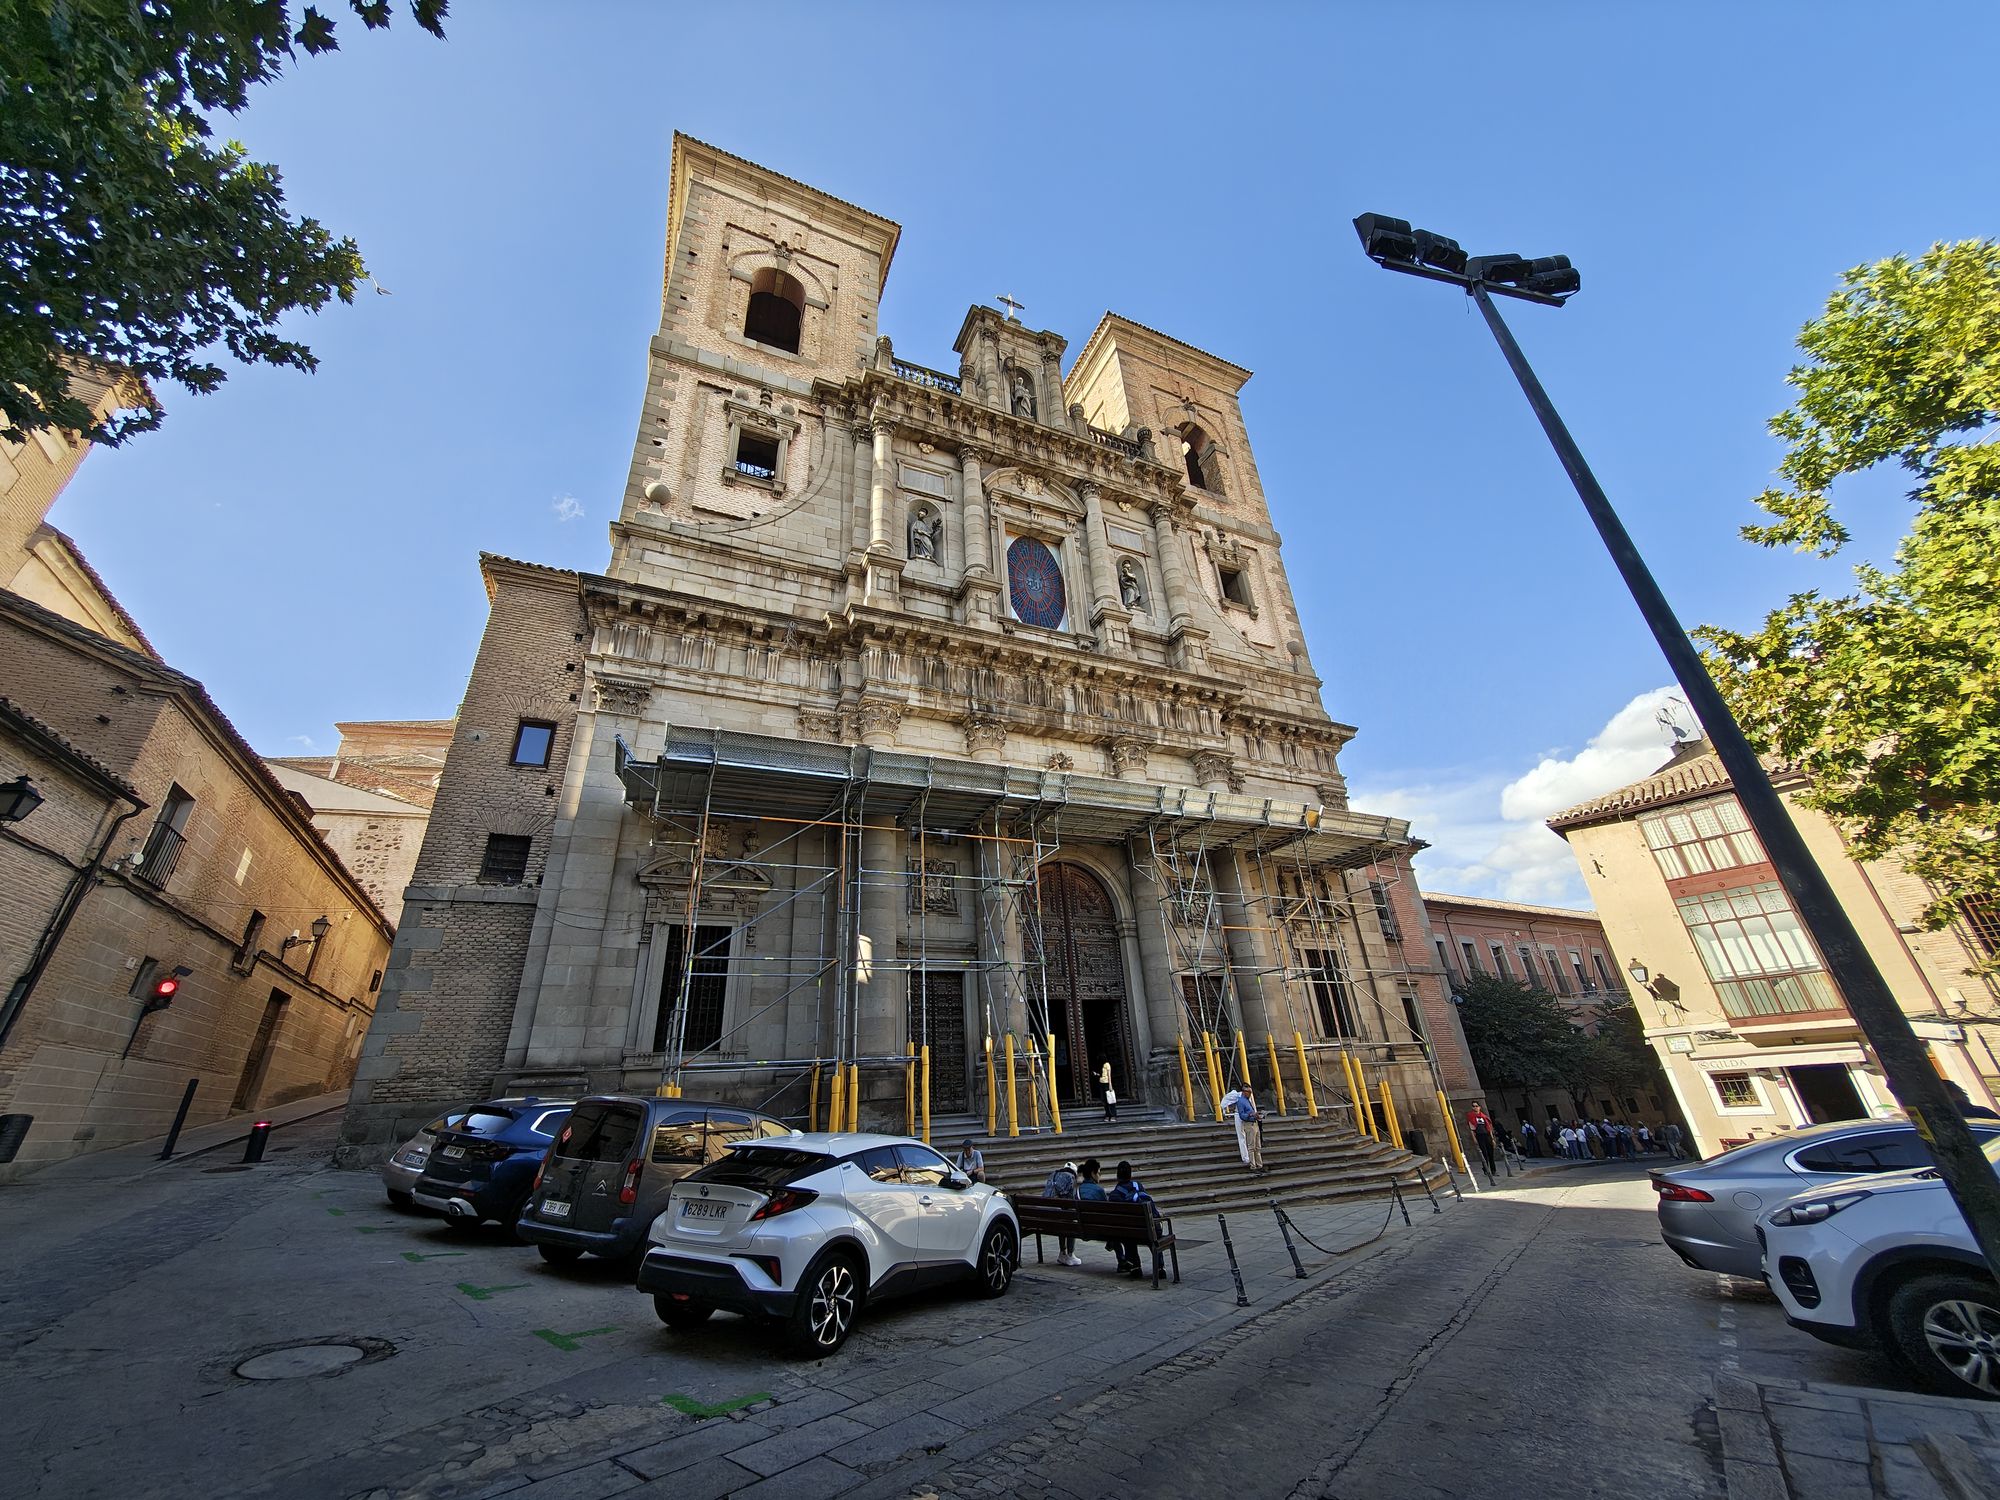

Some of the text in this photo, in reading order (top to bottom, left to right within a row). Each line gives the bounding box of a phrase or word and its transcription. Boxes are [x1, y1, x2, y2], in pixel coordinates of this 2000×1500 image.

[1710, 1059, 1748, 1070] GILDA
[688, 1203, 727, 1219] 6289 LKR
